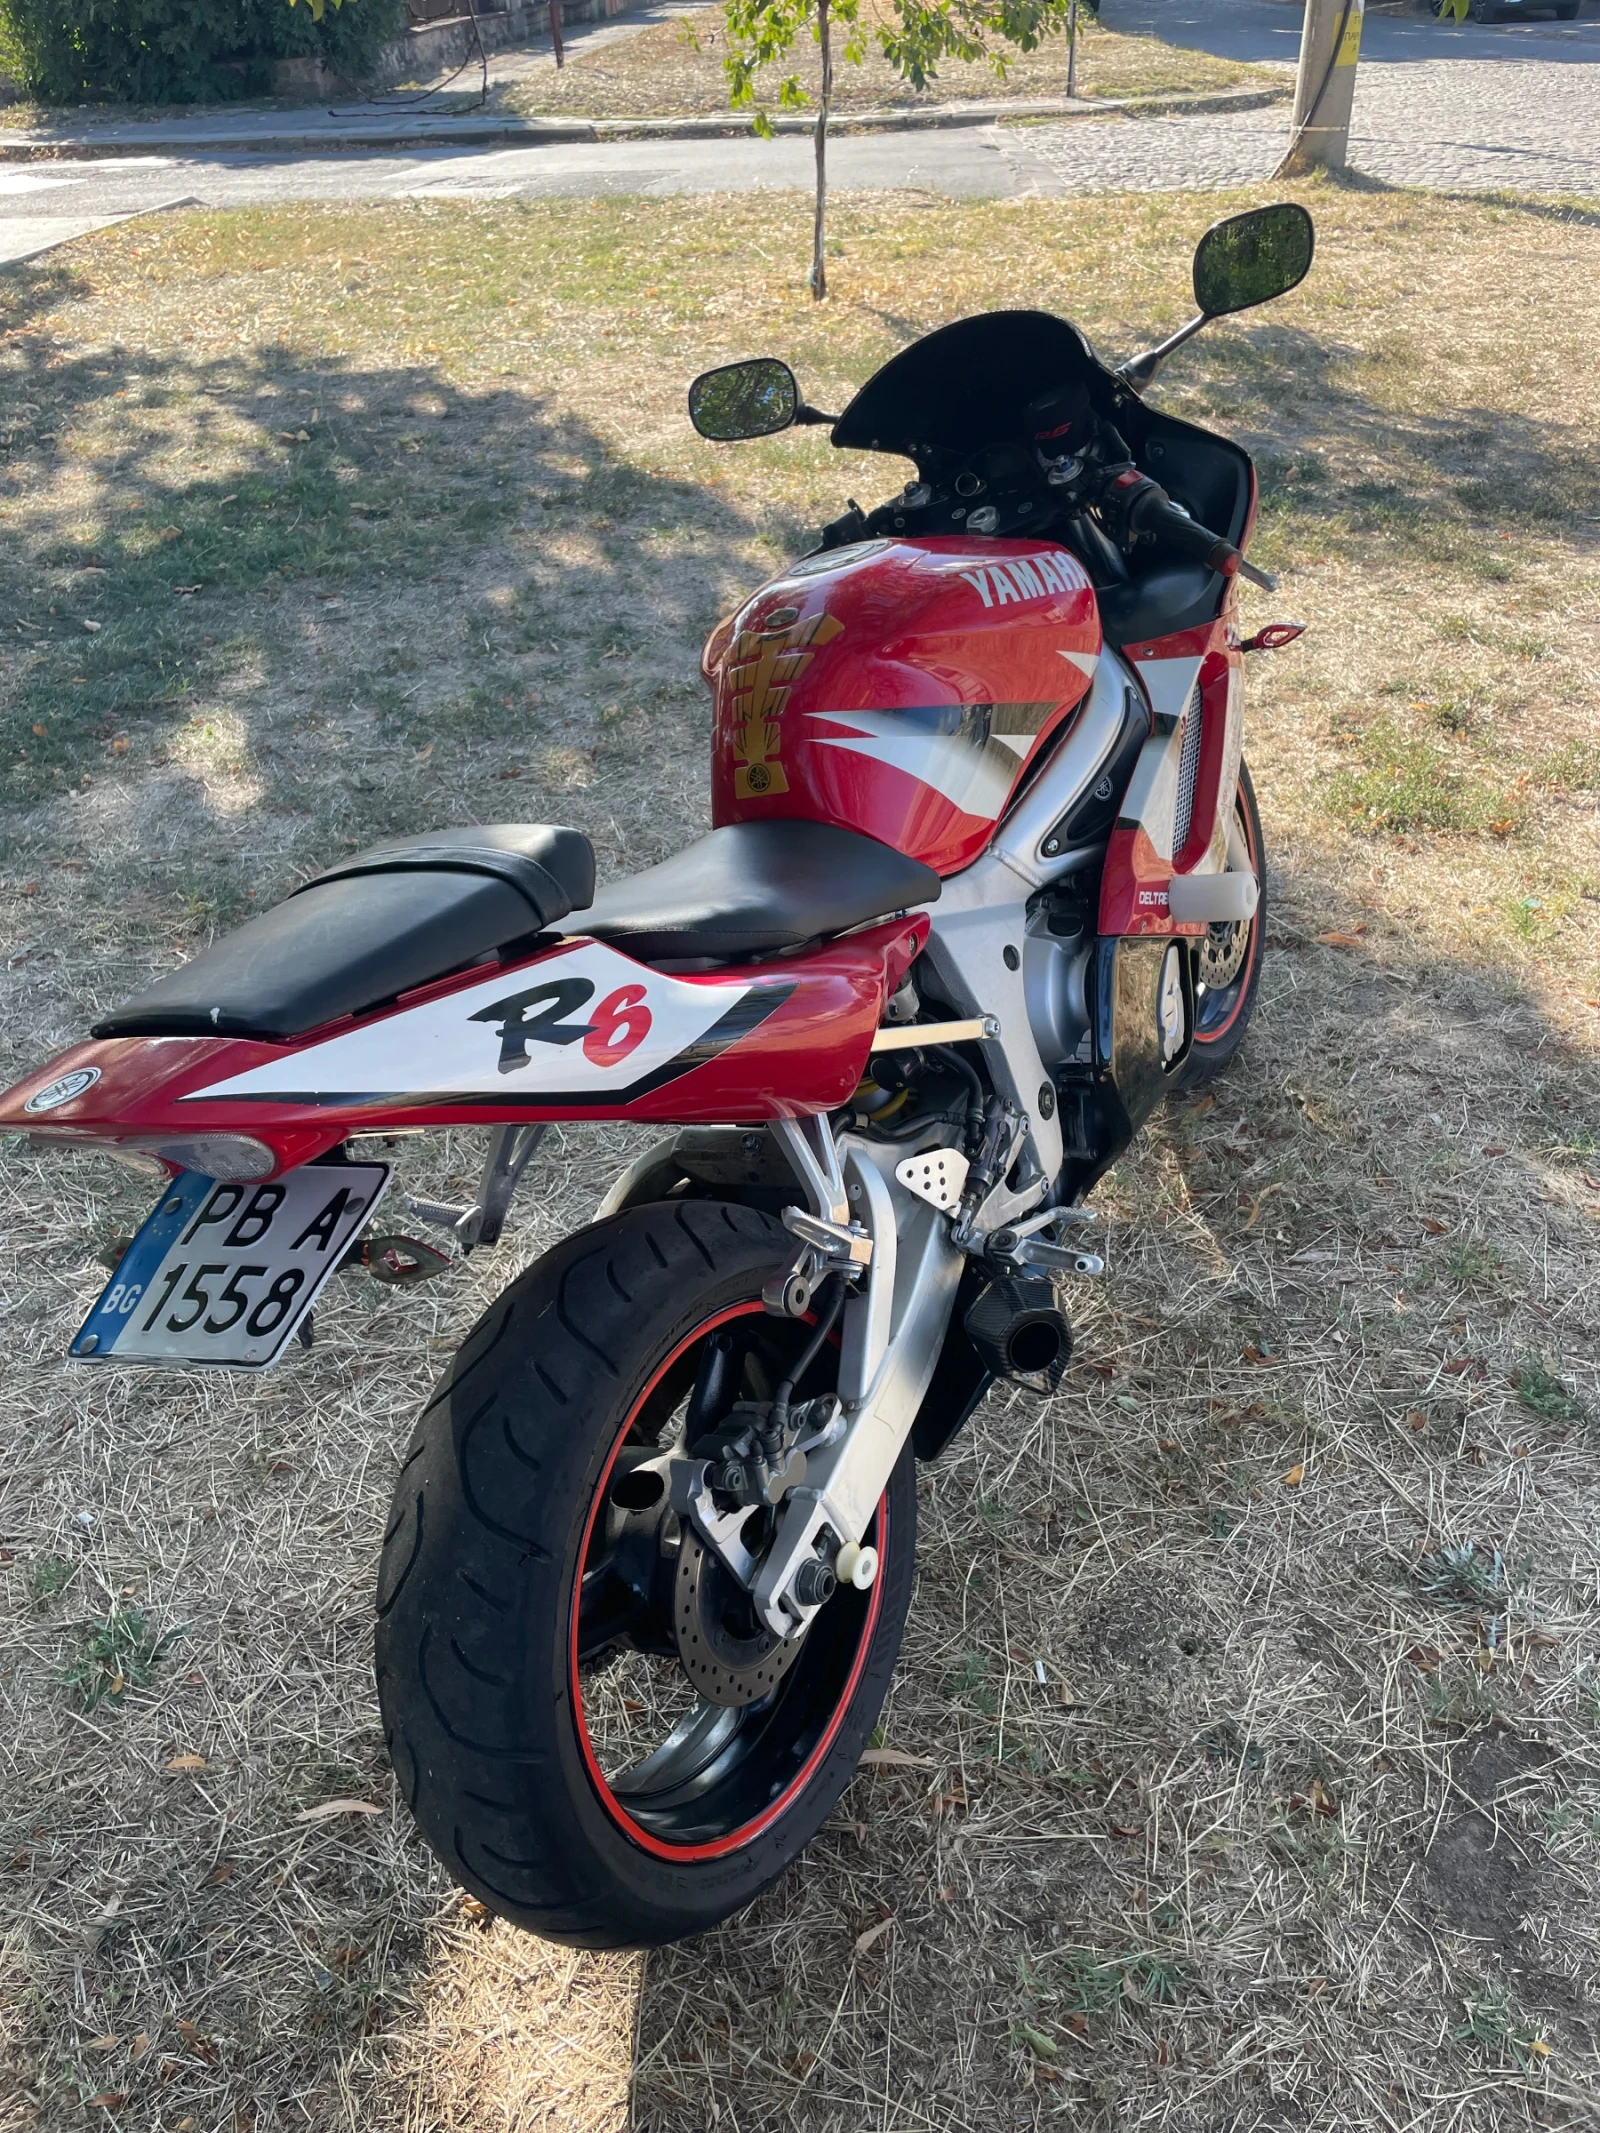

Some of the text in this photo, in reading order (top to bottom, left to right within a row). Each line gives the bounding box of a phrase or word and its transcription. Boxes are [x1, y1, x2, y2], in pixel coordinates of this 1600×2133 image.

[959, 551, 1092, 607] YAMAHA
[466, 977, 652, 1075] R6
[180, 1184, 352, 1251] PB A
[101, 1284, 142, 1314] BG
[142, 1263, 305, 1337] 1558
